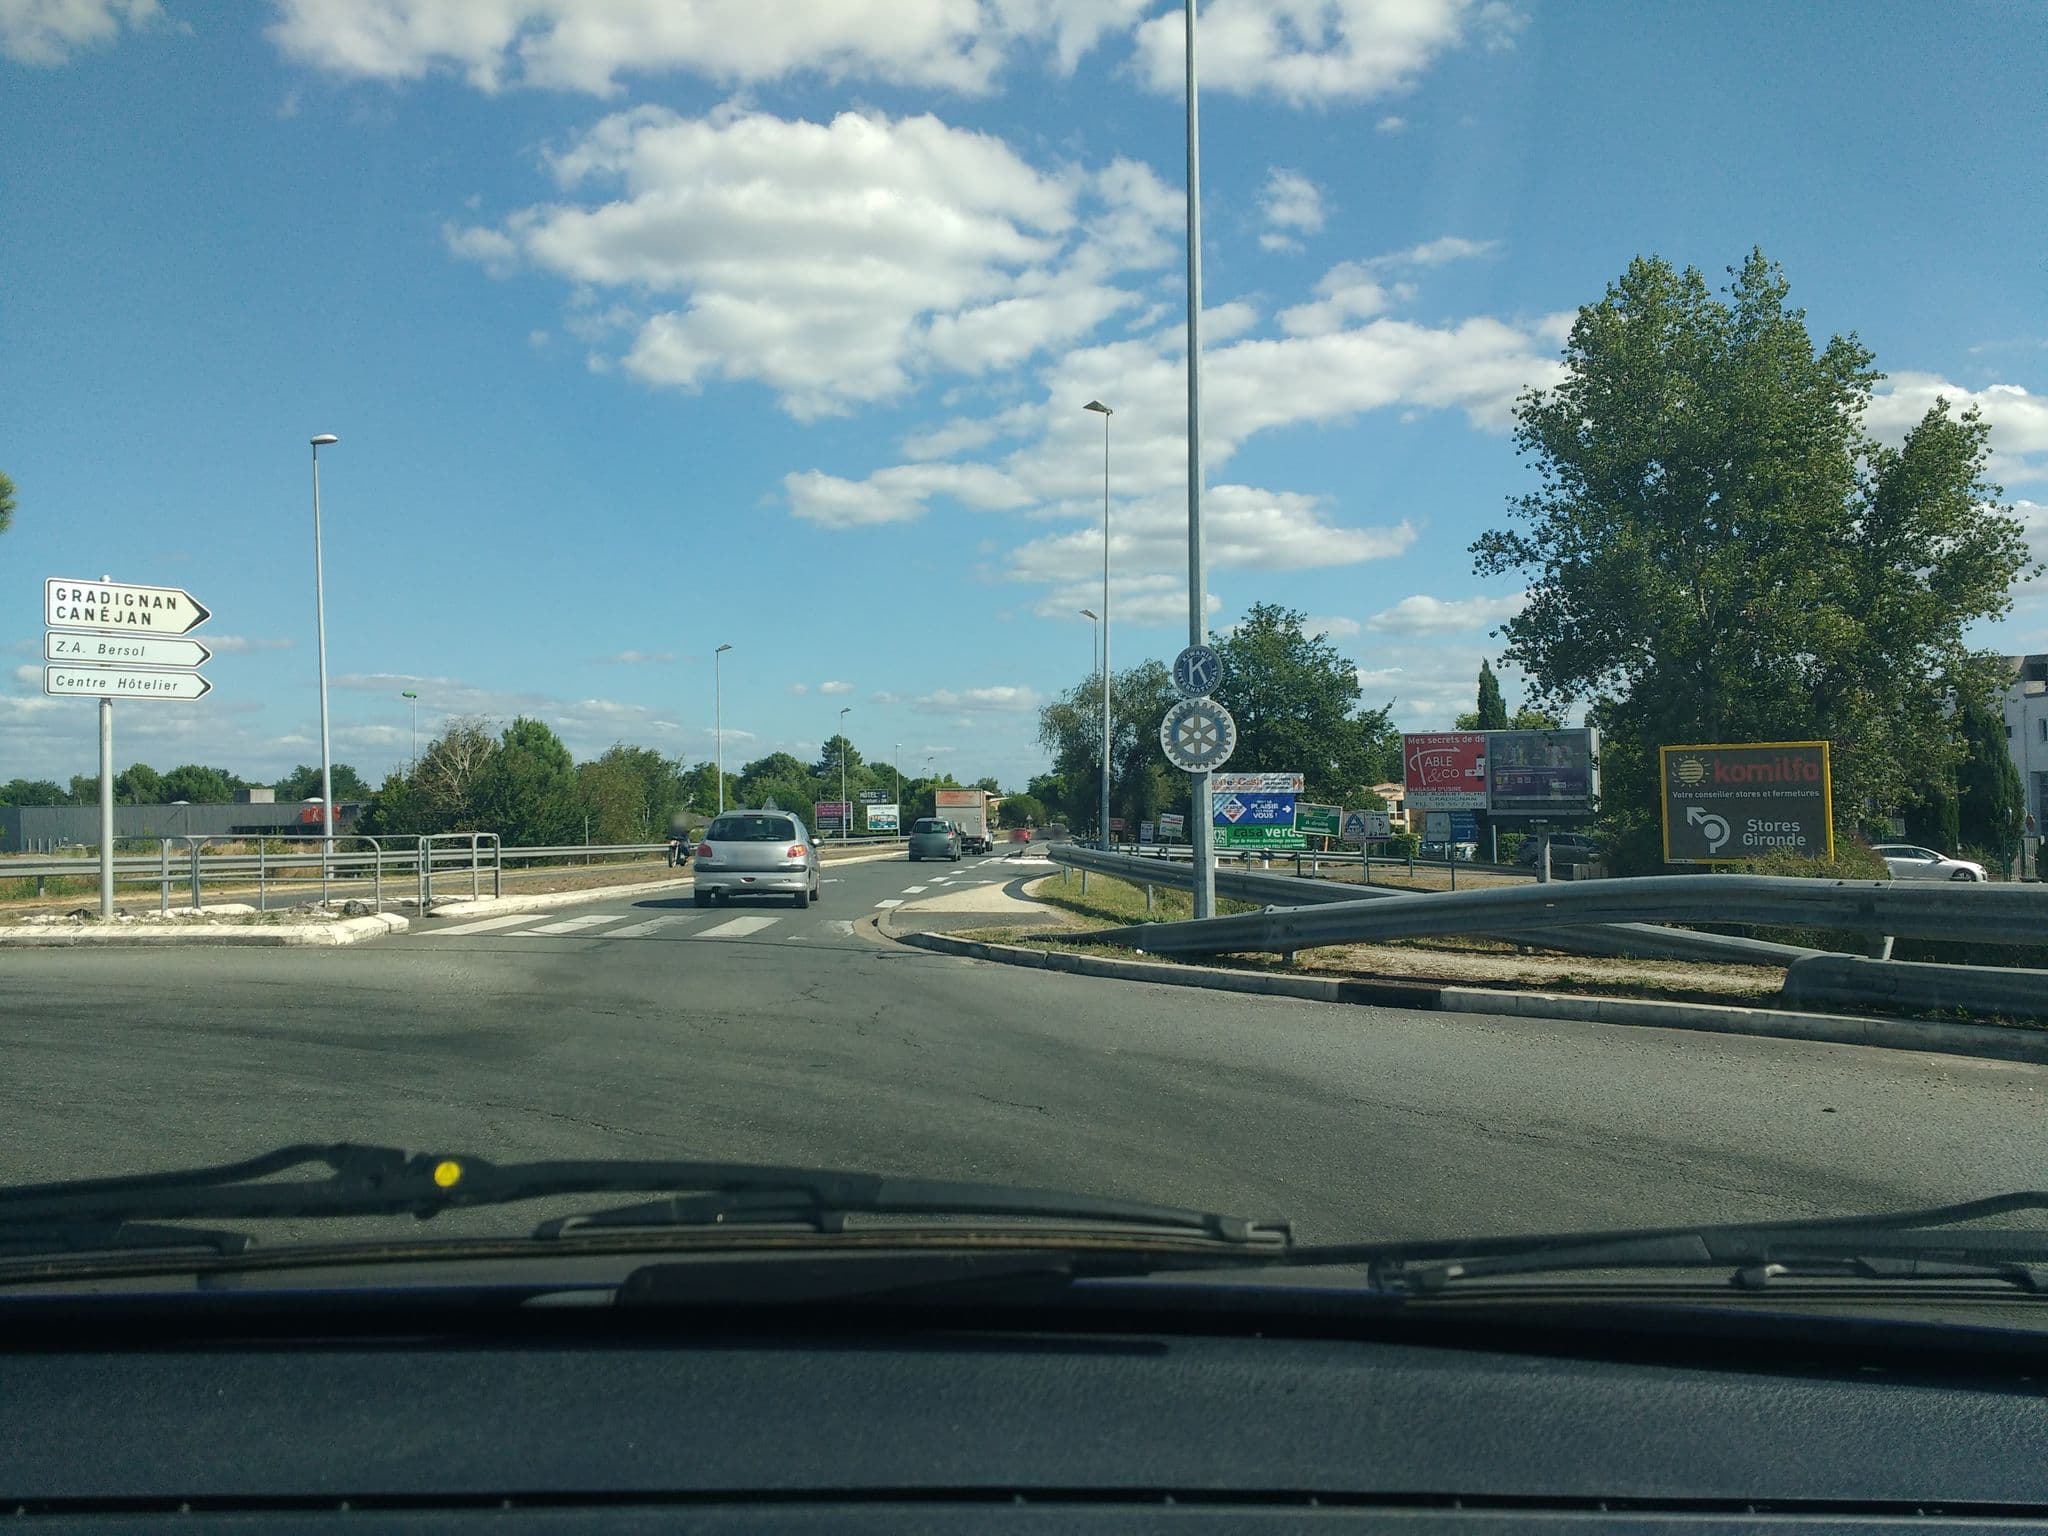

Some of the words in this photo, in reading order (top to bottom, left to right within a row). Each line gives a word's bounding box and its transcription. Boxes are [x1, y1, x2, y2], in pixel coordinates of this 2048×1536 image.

[56, 588, 176, 610] GRADIGNAN
[56, 606, 151, 625] CANÉJAN
[56, 641, 85, 653] Z.A.
[98, 643, 145, 657] Bersol
[1187, 656, 1207, 686] K
[56, 675, 106, 688] Centre
[117, 677, 178, 691] Hôtelier
[1408, 736, 1425, 744] Mes
[1427, 734, 1460, 743] secrets
[1462, 734, 1473, 742] de
[1714, 757, 1820, 783] komilfo
[1695, 790, 1734, 798] conseiller
[1736, 790, 1761, 798] stores
[1234, 828, 1262, 837] casa
[1747, 819, 1801, 832] Stores
[1743, 833, 1806, 846] Gironde
